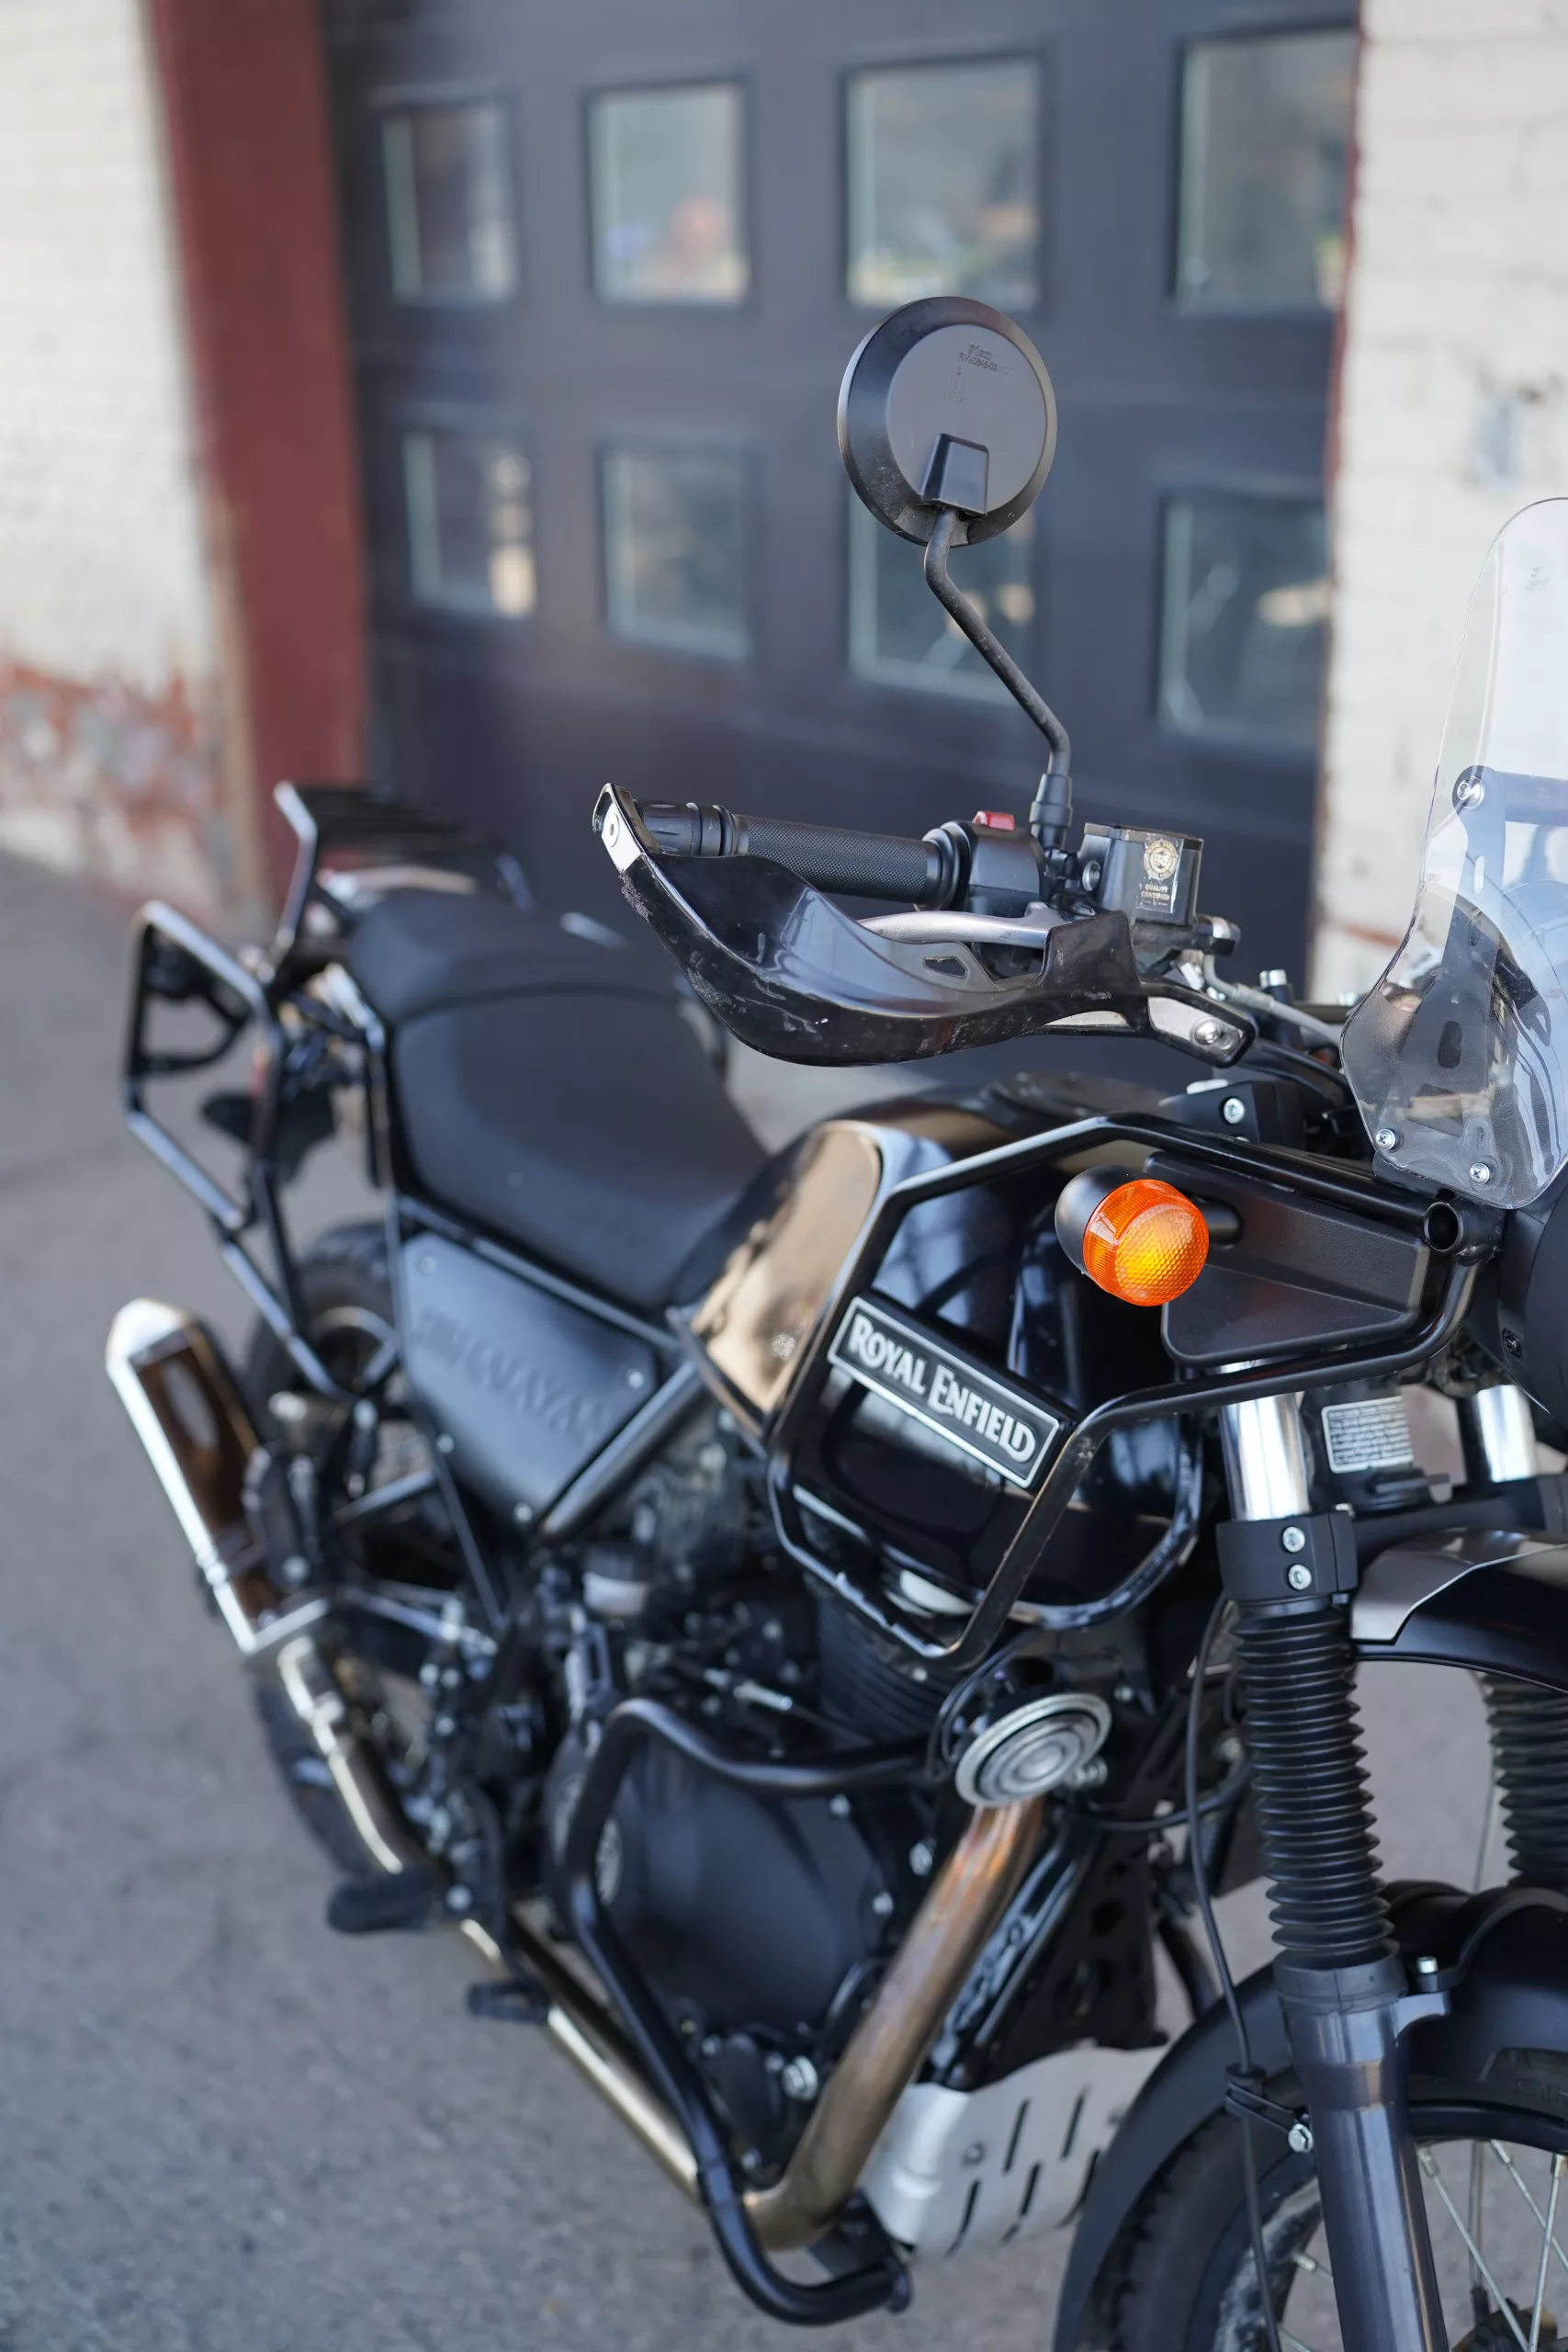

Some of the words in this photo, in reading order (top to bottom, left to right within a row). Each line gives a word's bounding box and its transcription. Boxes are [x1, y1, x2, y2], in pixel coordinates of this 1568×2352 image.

[1145, 884, 1168, 893] QUALITY
[1141, 890, 1170, 900] CERTIFIED
[847, 1313, 927, 1396] ROYAL
[927, 1364, 1036, 1463] ENFIELD
